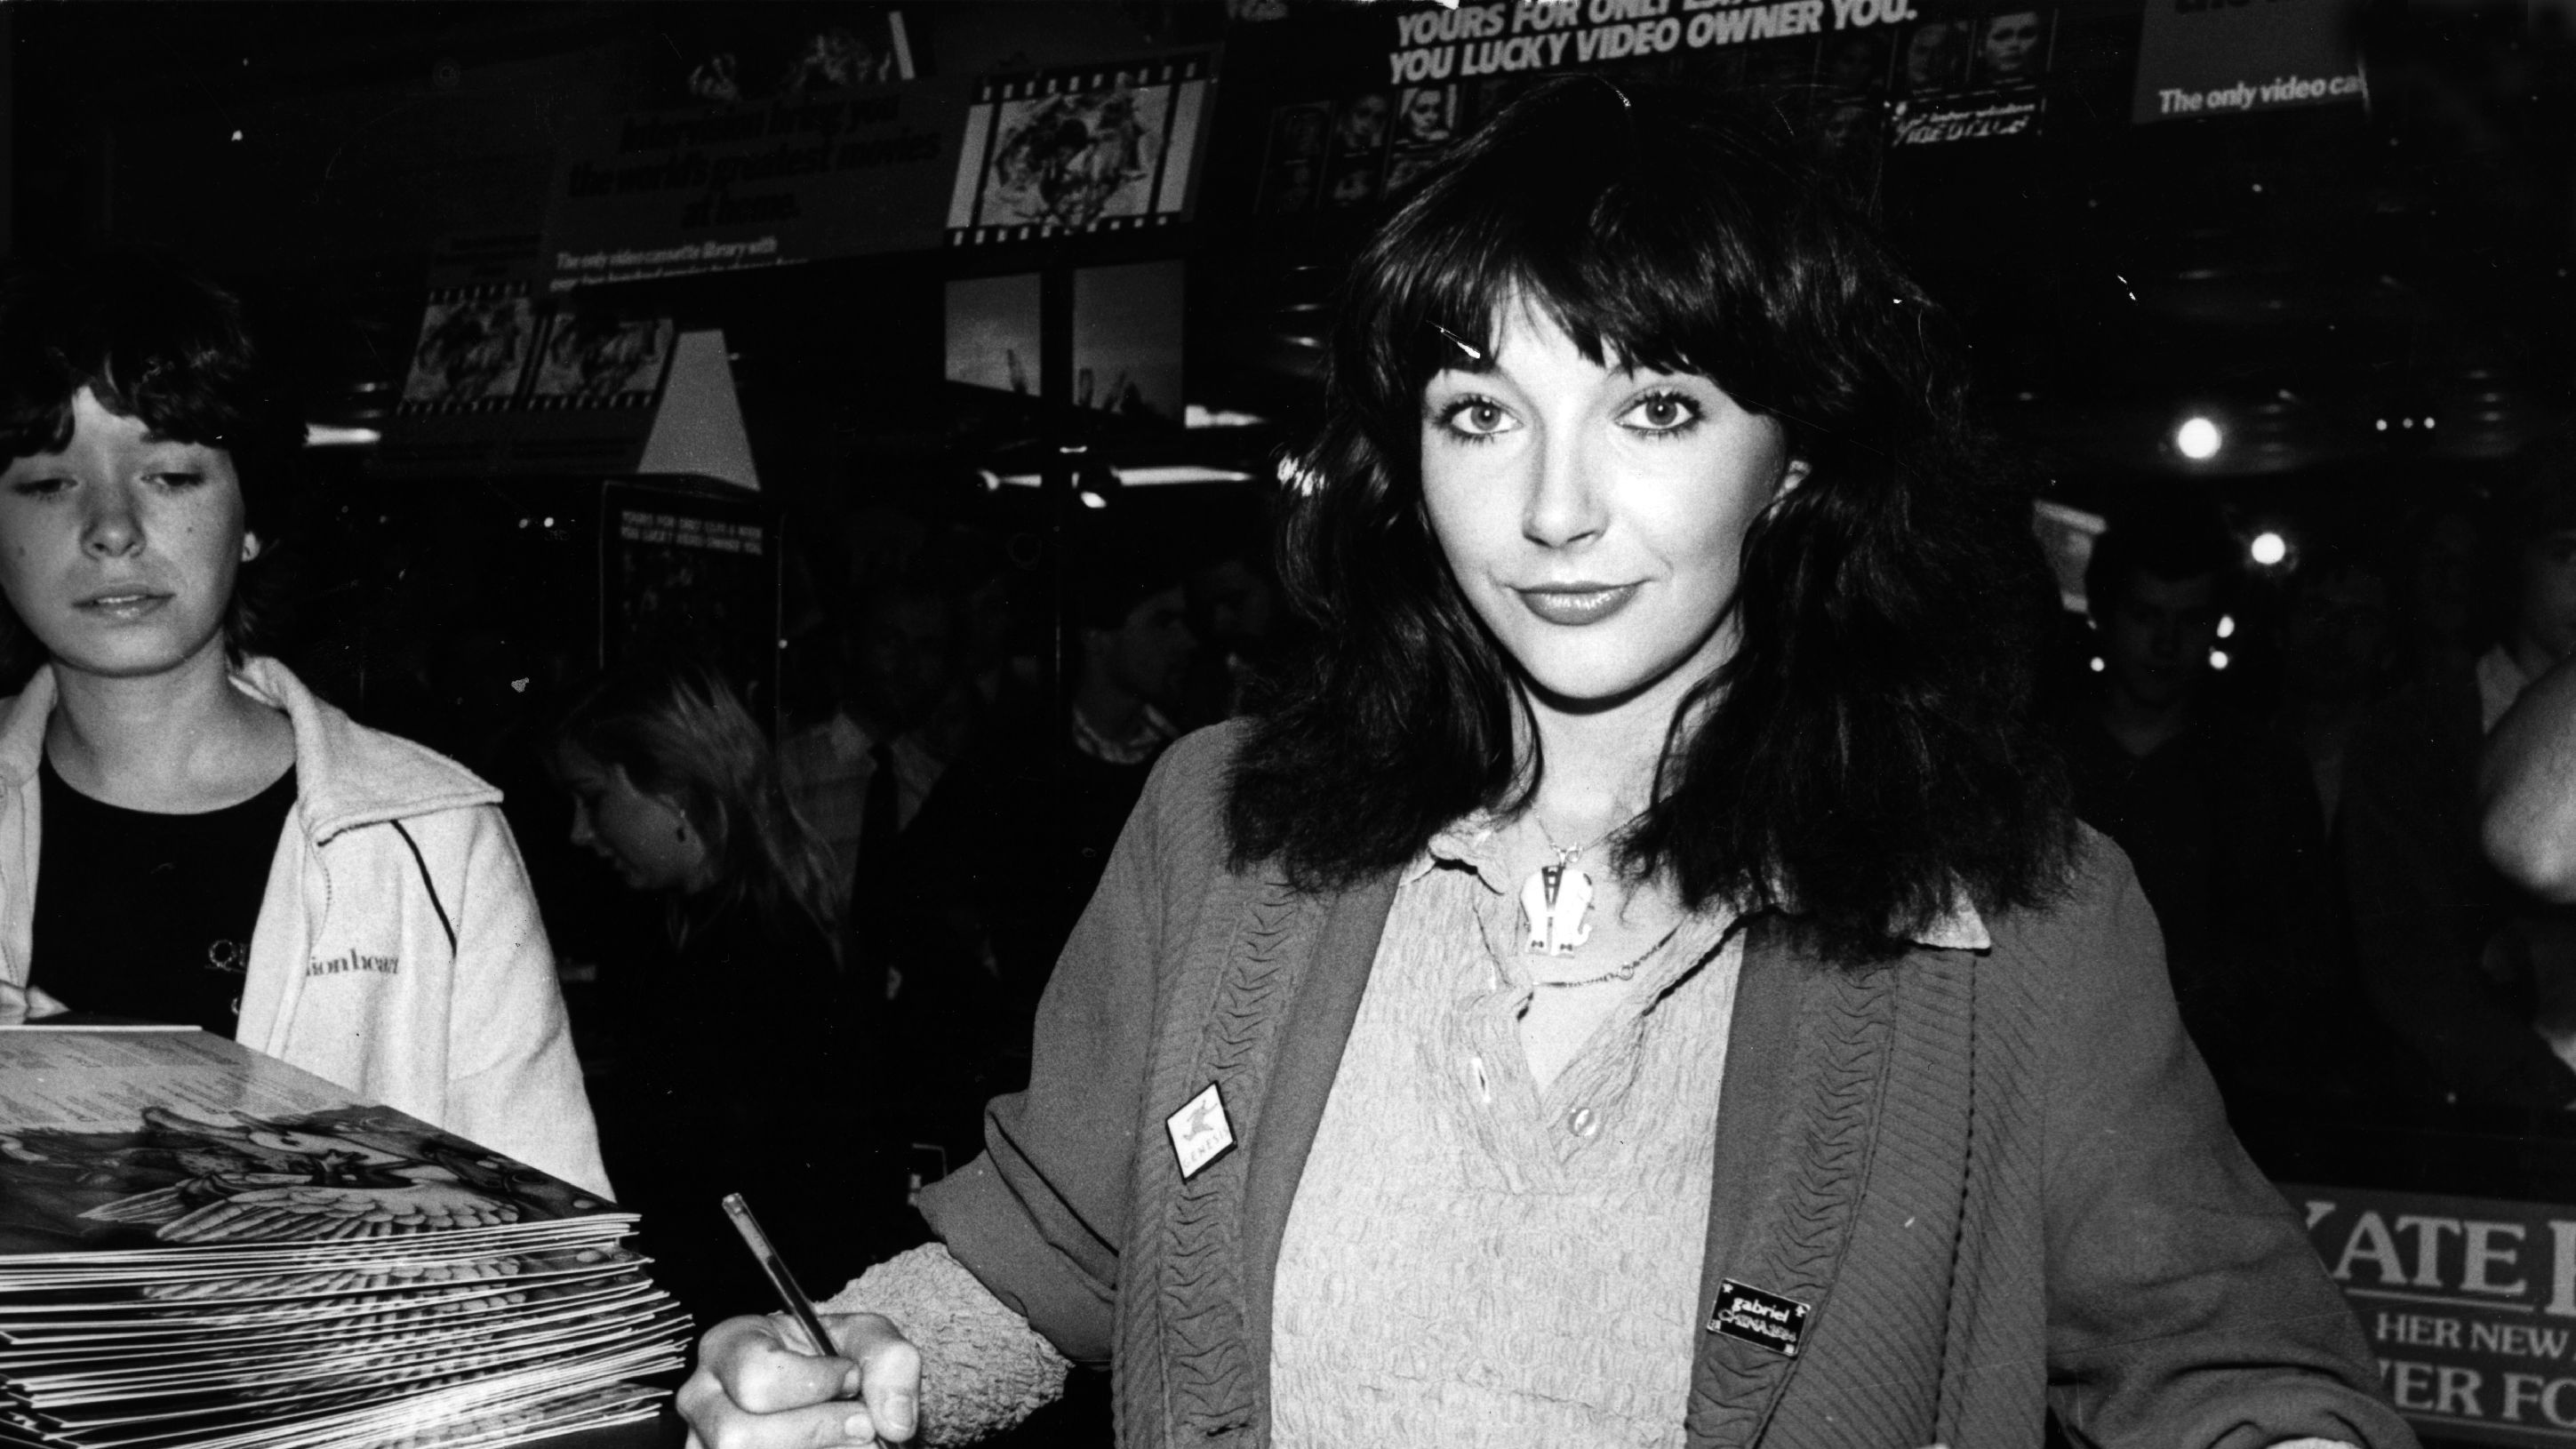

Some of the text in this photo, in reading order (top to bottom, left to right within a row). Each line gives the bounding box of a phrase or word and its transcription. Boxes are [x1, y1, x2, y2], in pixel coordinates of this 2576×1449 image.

[1388, 45, 1455, 84] YOU
[1460, 31, 1572, 76] LUCKY
[1576, 17, 1681, 62] VIDEO
[1686, 1, 1824, 48] OWNER
[1397, 3, 1506, 47] YOURS
[1511, 0, 1580, 34] FOR
[2158, 87, 2204, 114] The
[2205, 79, 2257, 110] only
[2260, 74, 2327, 102] video
[1732, 1298, 1790, 1323] gabriel
[2376, 1312, 2570, 1359] HER NEW
